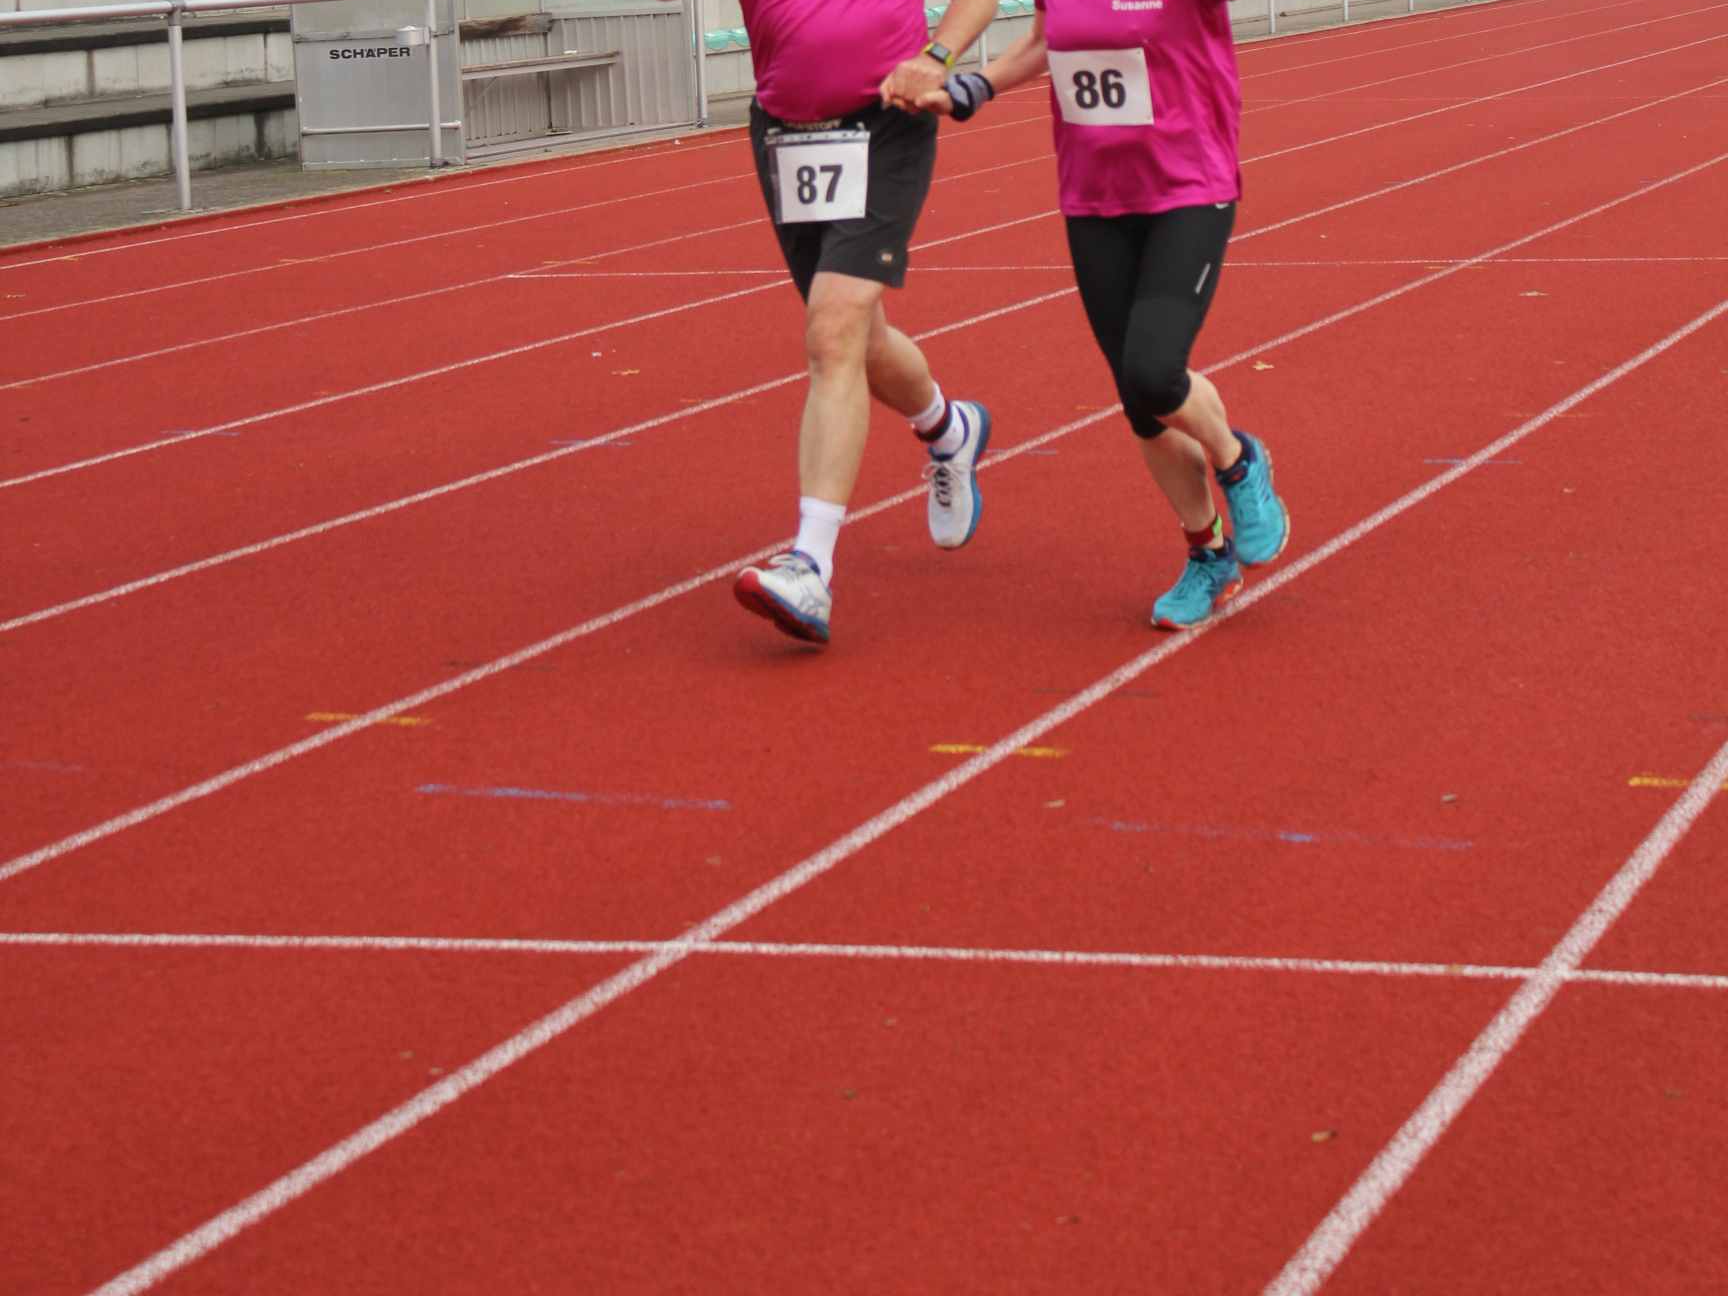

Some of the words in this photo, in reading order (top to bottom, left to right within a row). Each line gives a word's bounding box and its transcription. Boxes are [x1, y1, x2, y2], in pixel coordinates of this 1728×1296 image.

[1111, 0, 1164, 11] Susanne
[329, 47, 410, 59] SCHÄPER
[1073, 69, 1126, 109] 86
[797, 164, 843, 204] 87
